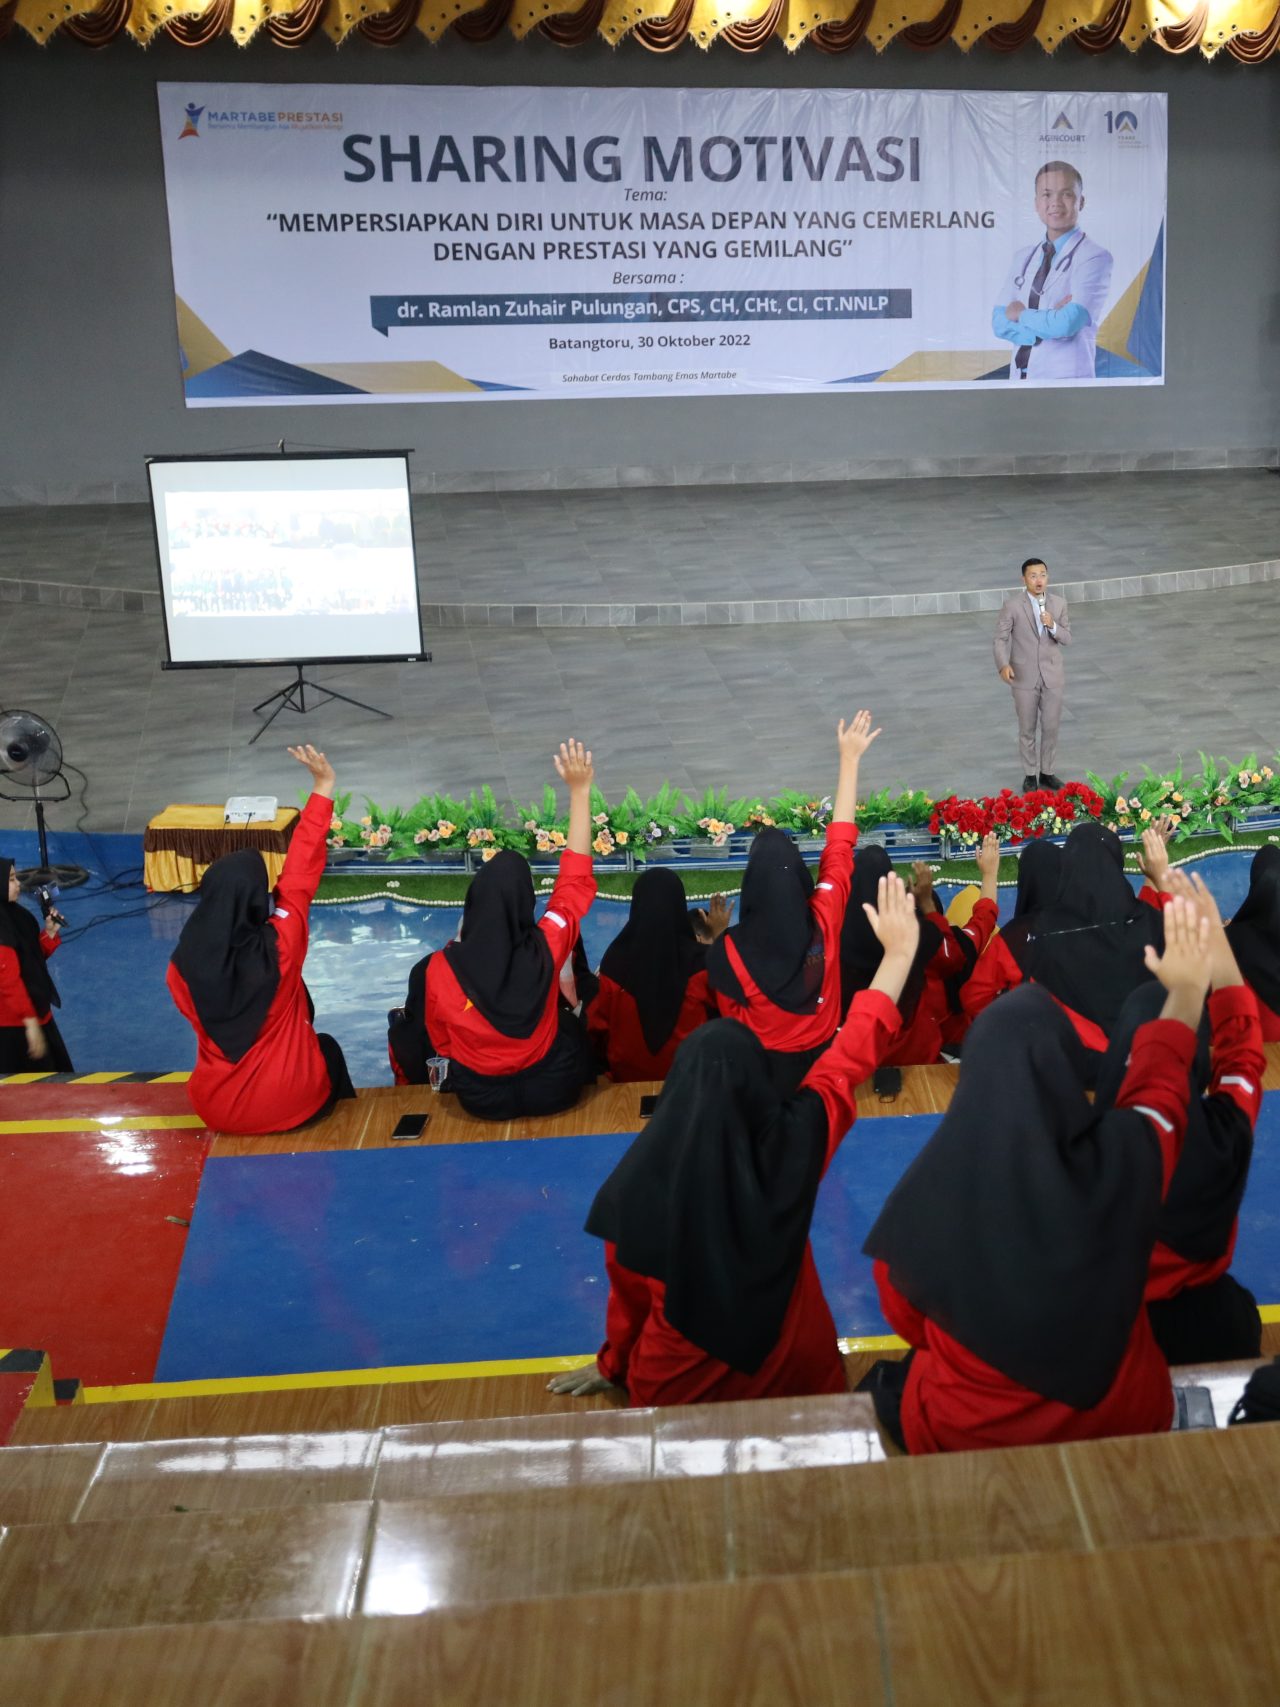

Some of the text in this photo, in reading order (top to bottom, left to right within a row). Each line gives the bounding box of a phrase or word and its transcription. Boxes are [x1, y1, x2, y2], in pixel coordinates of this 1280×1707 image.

[343, 133, 920, 184] SHARING MOTIVASI
[624, 188, 668, 201] Tema:
[267, 210, 995, 232] “MEMPERSIAPKAN DIRI UNTUK MASA DEPAN YANG CEMERLANG
[434, 239, 853, 261] DENGAN PRESTASI YANG GEMILANG”
[612, 271, 676, 285] Bersama
[397, 295, 889, 319] dr. Ramlan Zuhair Pulungan, CPS, CH, CHt, CI, CT.NNLP
[549, 334, 751, 353] Batangtoru, 30 Oktober 2022
[562, 370, 737, 383] Sahabat Cerdas Tambang Emas Martabe
